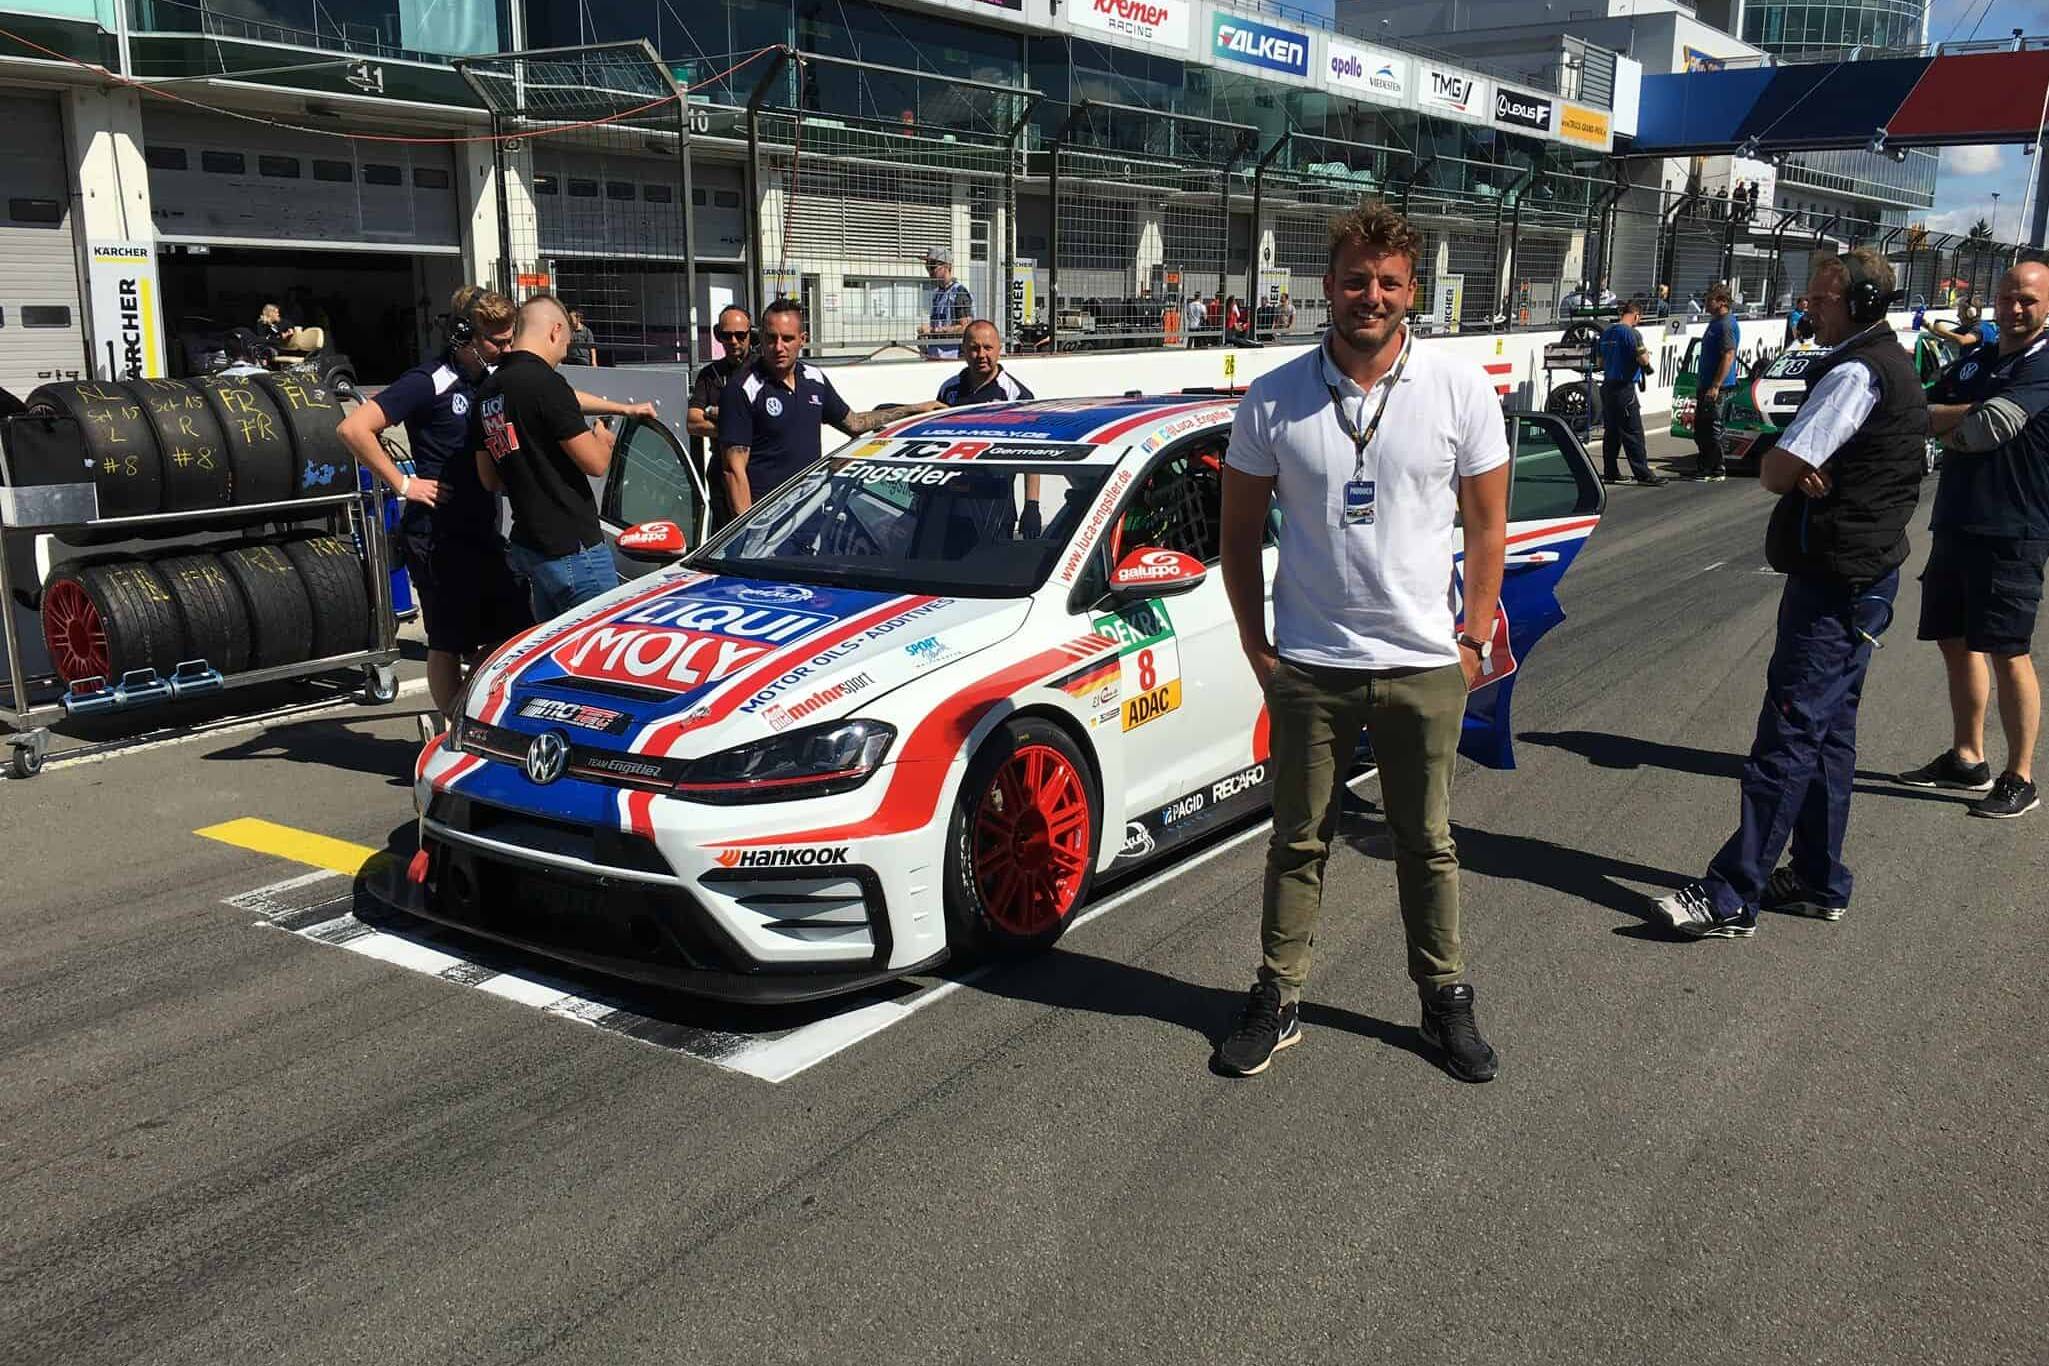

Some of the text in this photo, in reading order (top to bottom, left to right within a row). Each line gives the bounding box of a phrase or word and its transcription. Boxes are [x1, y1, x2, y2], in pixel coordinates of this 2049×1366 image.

[1108, 18, 1153, 38] RACING
[1217, 24, 1303, 66] FALKEN
[1331, 53, 1363, 80] apollo
[1431, 71, 1462, 99] TMG
[687, 109, 709, 132] 10
[1507, 101, 1536, 119] LEXUS
[94, 246, 147, 257] KÄRCHER
[1671, 320, 1681, 334] 9
[110, 427, 128, 442] L
[889, 440, 1066, 460] TCR Germany
[833, 459, 963, 485] Engstler
[1061, 470, 1132, 583] www.luca-engstler.de
[1118, 565, 1180, 581] galuppo
[624, 601, 820, 642] LIQUI
[1099, 605, 1171, 646] DEKRA
[569, 627, 768, 684] MOLY
[739, 598, 956, 714] MOTOR OILS ADDITIVES
[904, 636, 938, 656] SPORT
[1138, 649, 1156, 691] 8
[1128, 686, 1169, 727] ADAC
[1212, 764, 1265, 804] RECARO
[1173, 793, 1204, 822] PAGID
